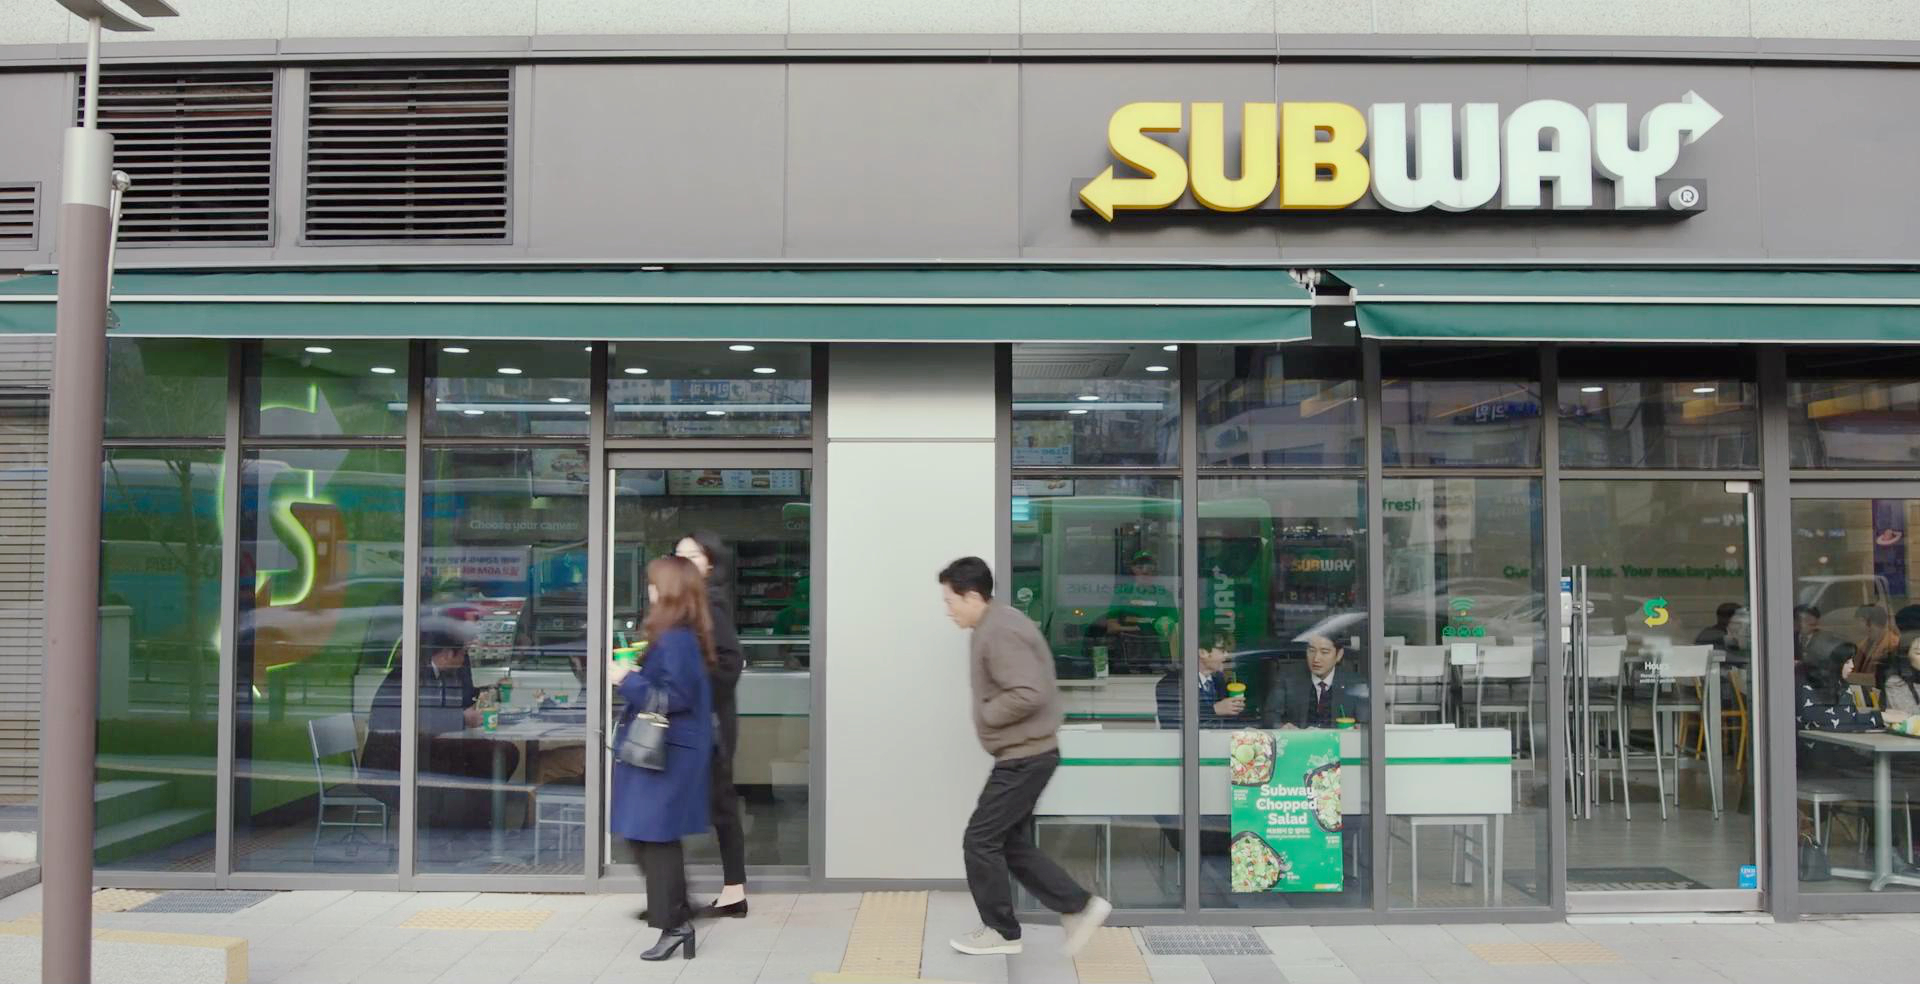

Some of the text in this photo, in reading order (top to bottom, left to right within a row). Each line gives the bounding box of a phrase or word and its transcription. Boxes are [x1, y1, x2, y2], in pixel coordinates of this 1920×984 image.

[1079, 90, 1723, 222] SUBWAY
[1382, 498, 1421, 511] fresh
[470, 519, 512, 530] Choose
[1289, 559, 1356, 572] SUBWAY
[1621, 564, 1653, 577] Your
[1260, 784, 1314, 799] Subway
[1256, 798, 1318, 812] Chopped
[1268, 813, 1308, 825] Salad
